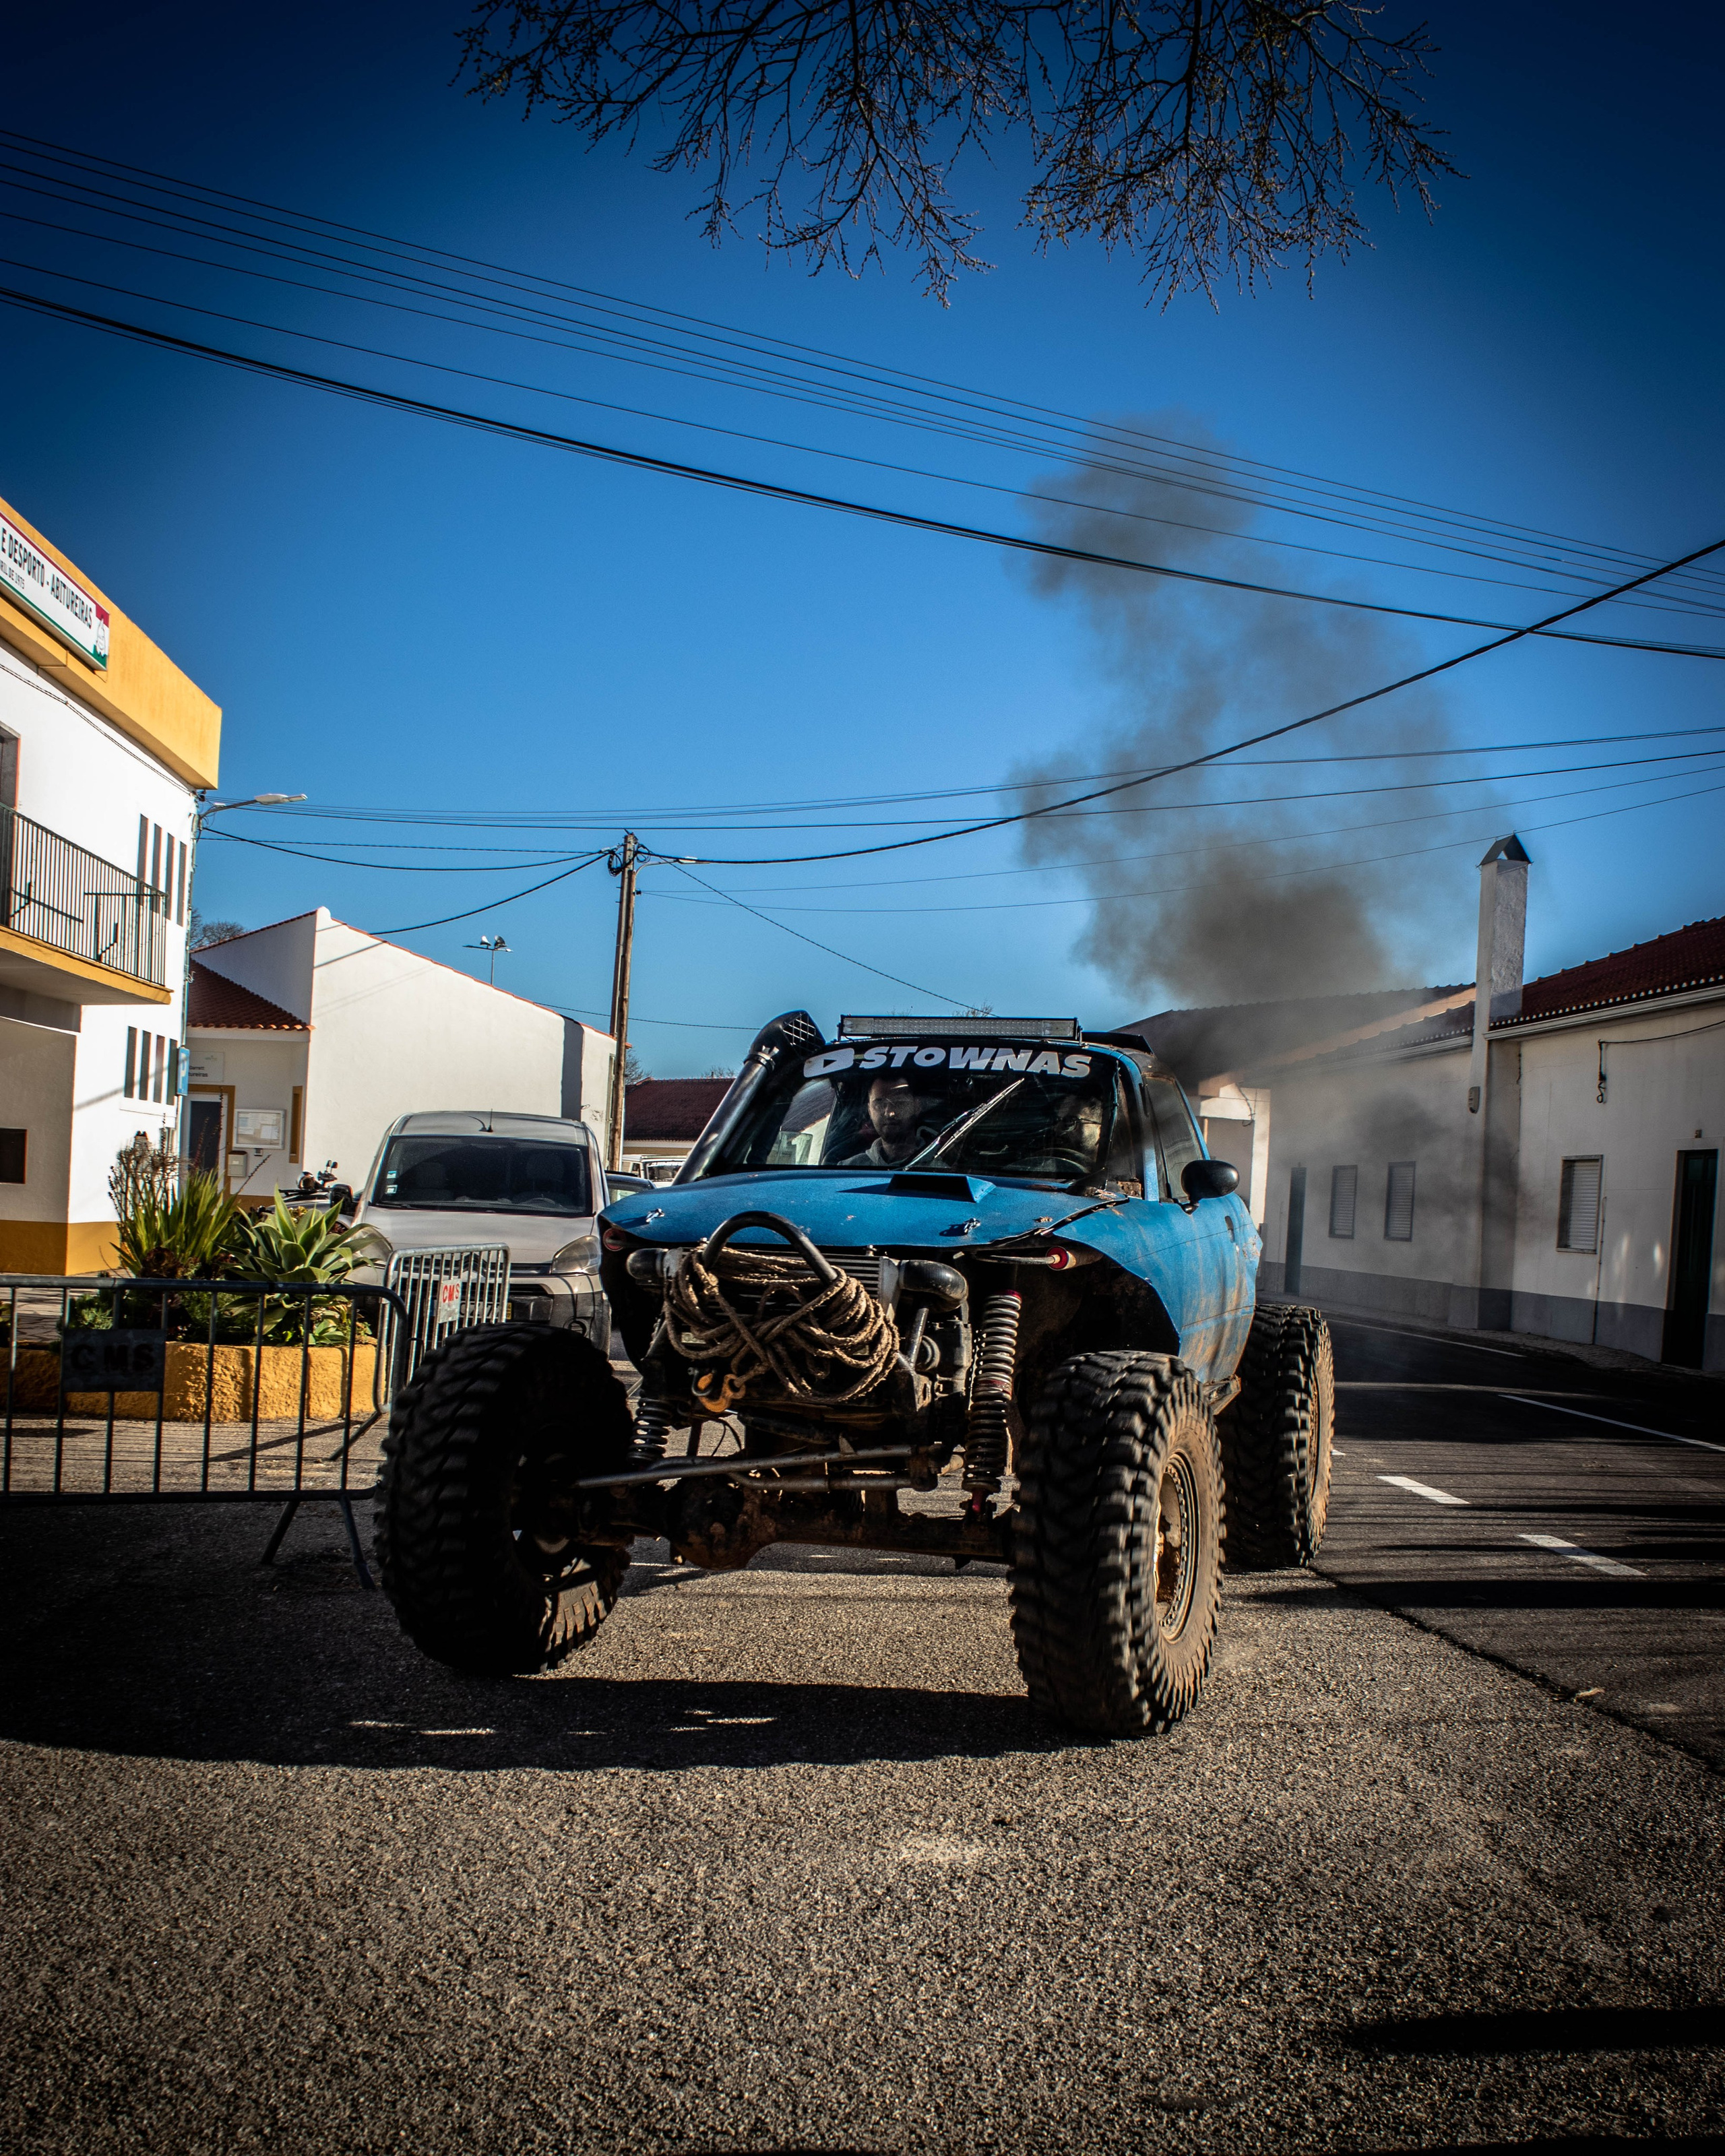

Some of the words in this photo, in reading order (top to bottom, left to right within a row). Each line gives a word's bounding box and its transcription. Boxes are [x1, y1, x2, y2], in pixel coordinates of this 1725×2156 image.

[1, 528, 7, 554] E
[8, 534, 45, 588] DESPORTO
[51, 574, 92, 629] ABITUREIRAS
[9, 567, 14, 581] DE
[15, 573, 25, 590] 1975
[179, 1052, 187, 1089] P
[442, 1283, 460, 1303] CMS
[71, 1345, 154, 1372] CMS
